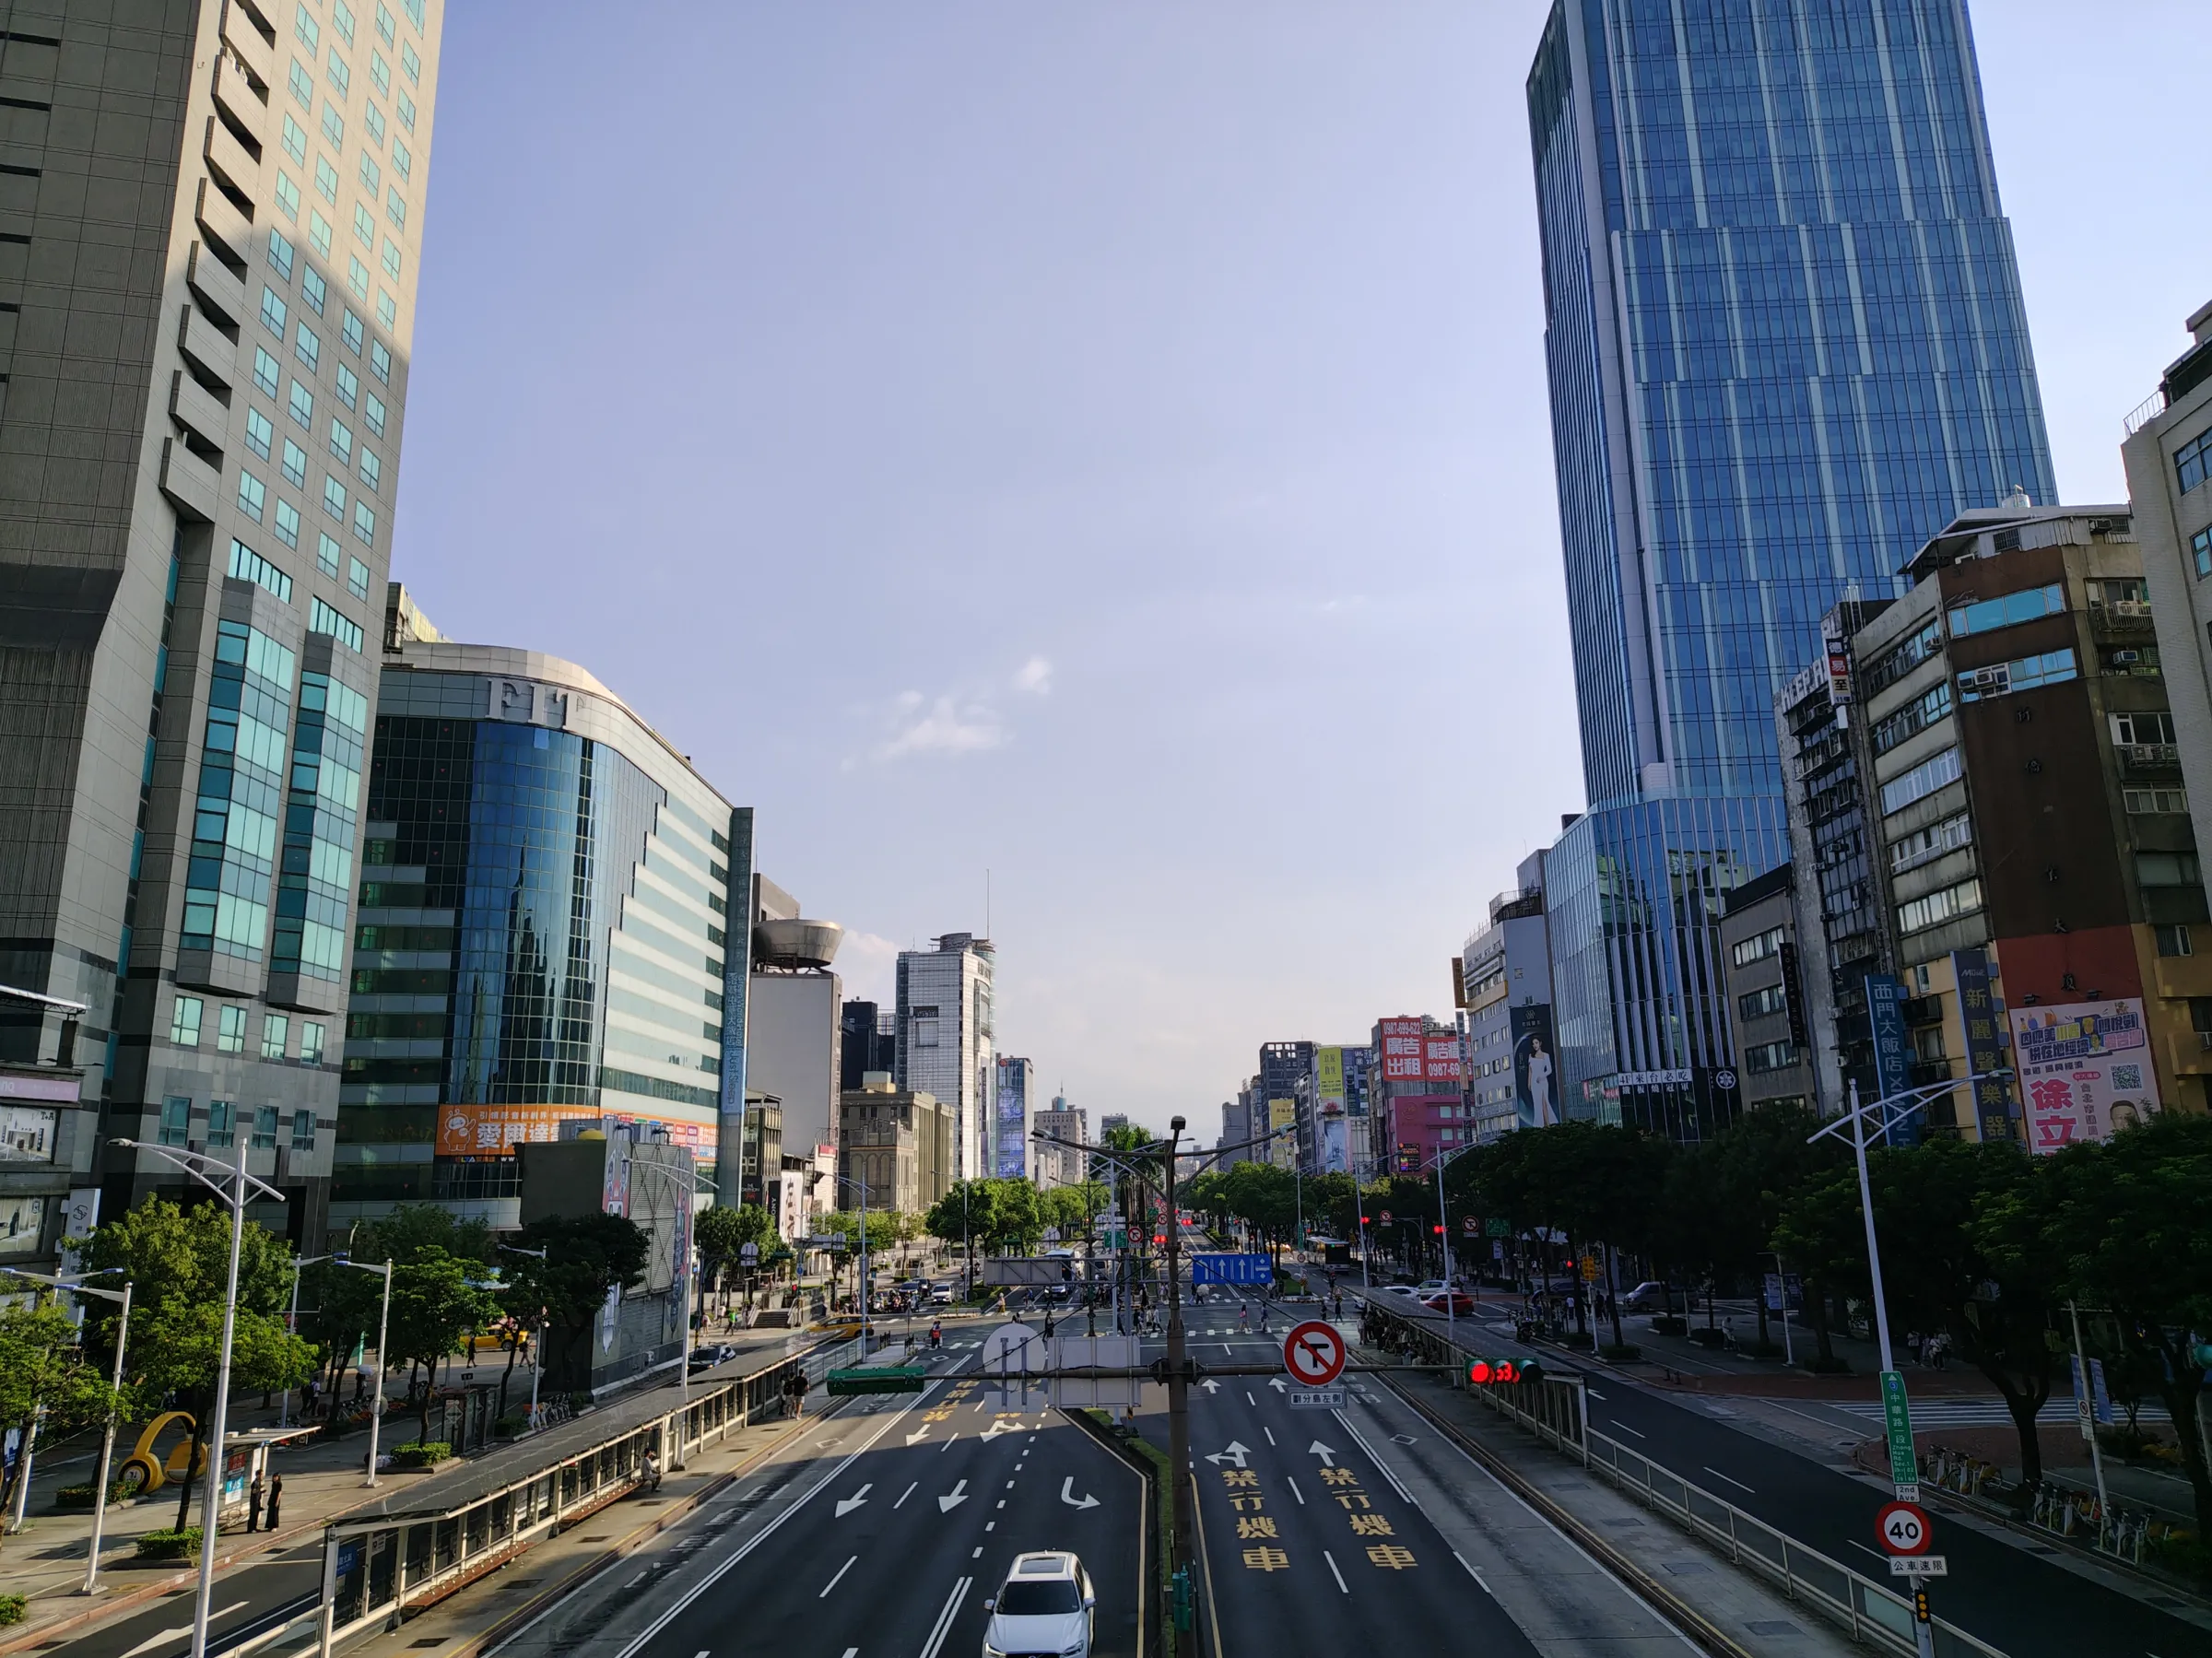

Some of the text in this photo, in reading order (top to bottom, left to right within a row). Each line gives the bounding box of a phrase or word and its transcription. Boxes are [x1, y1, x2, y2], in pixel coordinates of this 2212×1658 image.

[485, 677, 588, 735] FIT
[1386, 1038, 1420, 1055] 廣告
[1873, 983, 1904, 1073] 西門大飯店
[1387, 1058, 1421, 1076] 出租
[2030, 1079, 2080, 1157] 徐立
[1890, 1393, 1906, 1443] 中華路一段
[1221, 1469, 1290, 1571] 禁行機車
[1319, 1467, 1419, 1570] 禁行機車
[1889, 1522, 1919, 1539] 40
[1894, 1560, 1944, 1571] 公車速限
